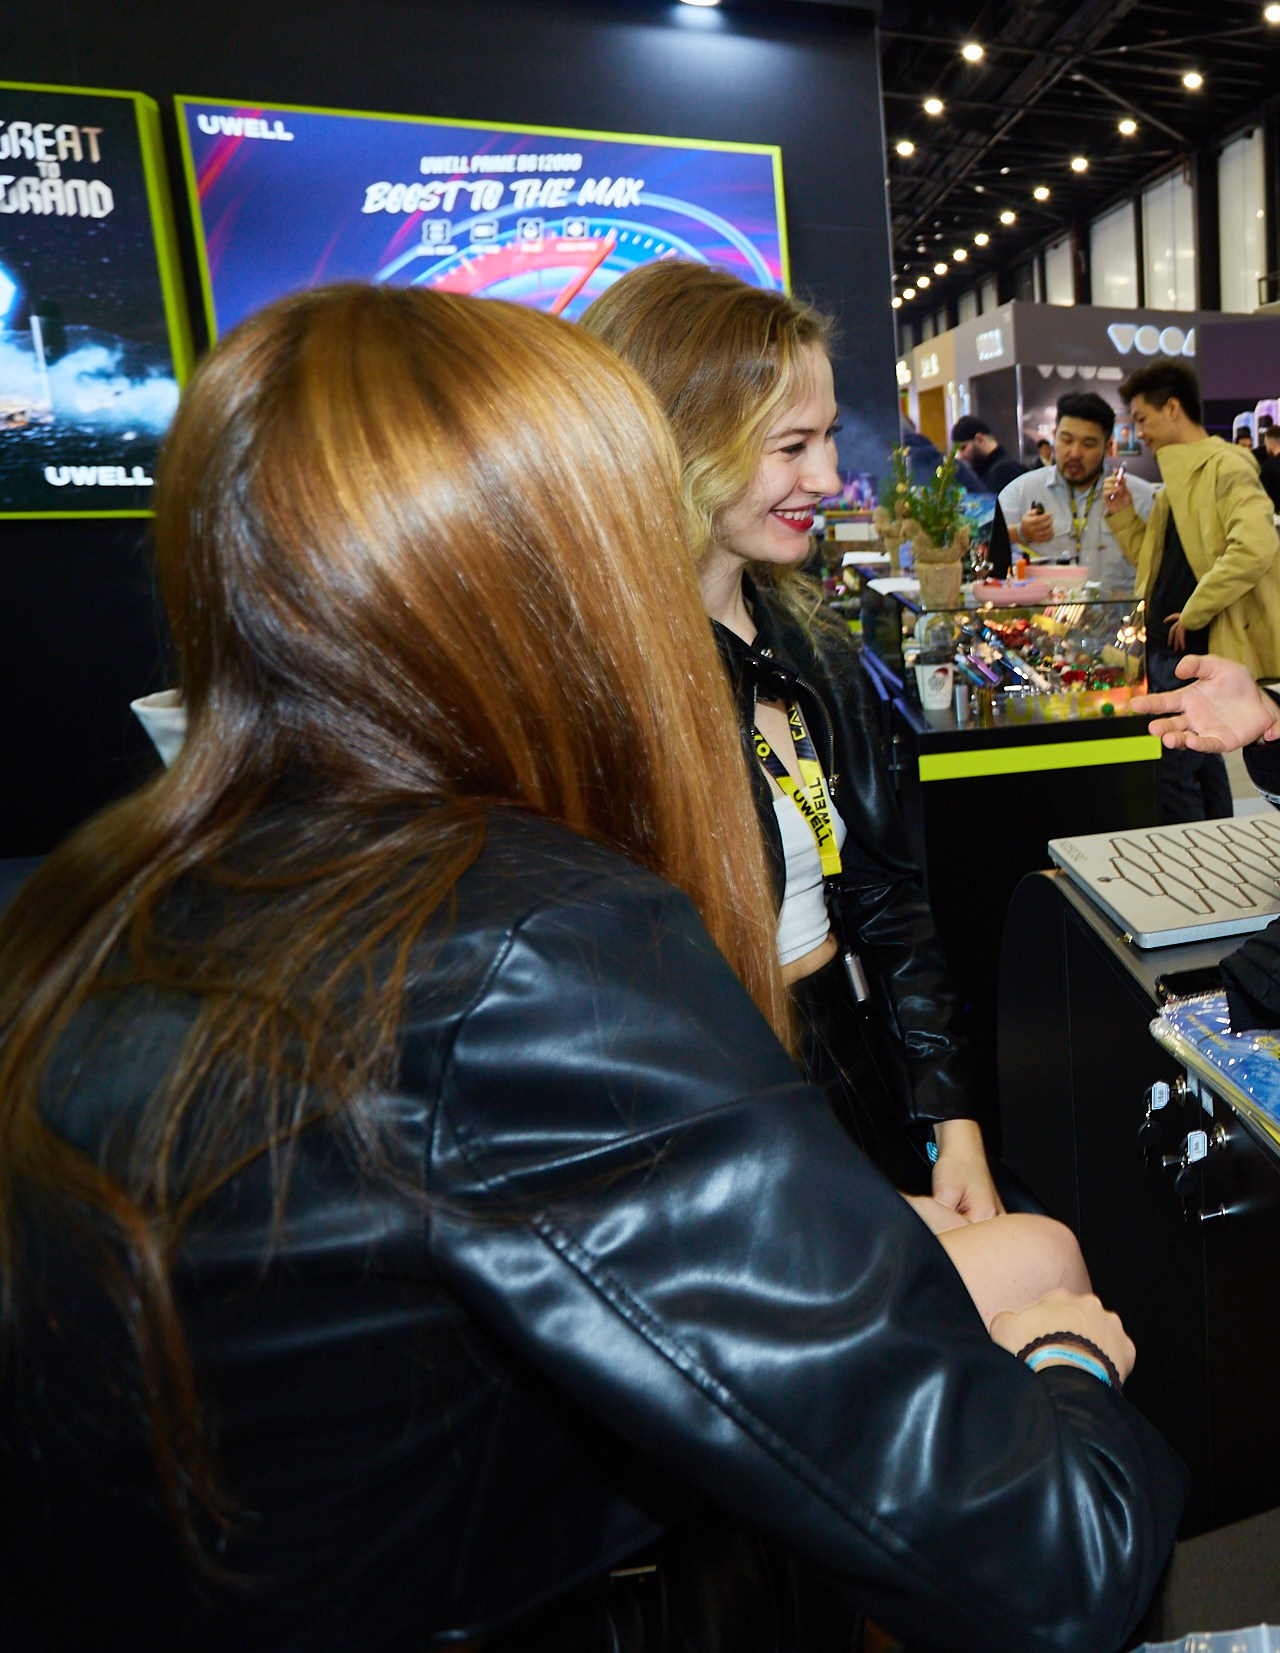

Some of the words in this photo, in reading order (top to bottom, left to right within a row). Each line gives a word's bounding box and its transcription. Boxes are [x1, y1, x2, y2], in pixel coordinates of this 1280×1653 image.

[197, 113, 295, 141] UWELL
[35, 161, 61, 179] TO
[420, 155, 470, 175] UWELL
[0, 174, 115, 219] GRAND
[361, 180, 469, 214] BOOST
[467, 179, 505, 212] TO
[509, 177, 576, 209] THE
[576, 176, 645, 208] MAX
[44, 465, 155, 487] UWELL
[793, 789, 825, 848] UWELL
[809, 777, 833, 835] WELL
